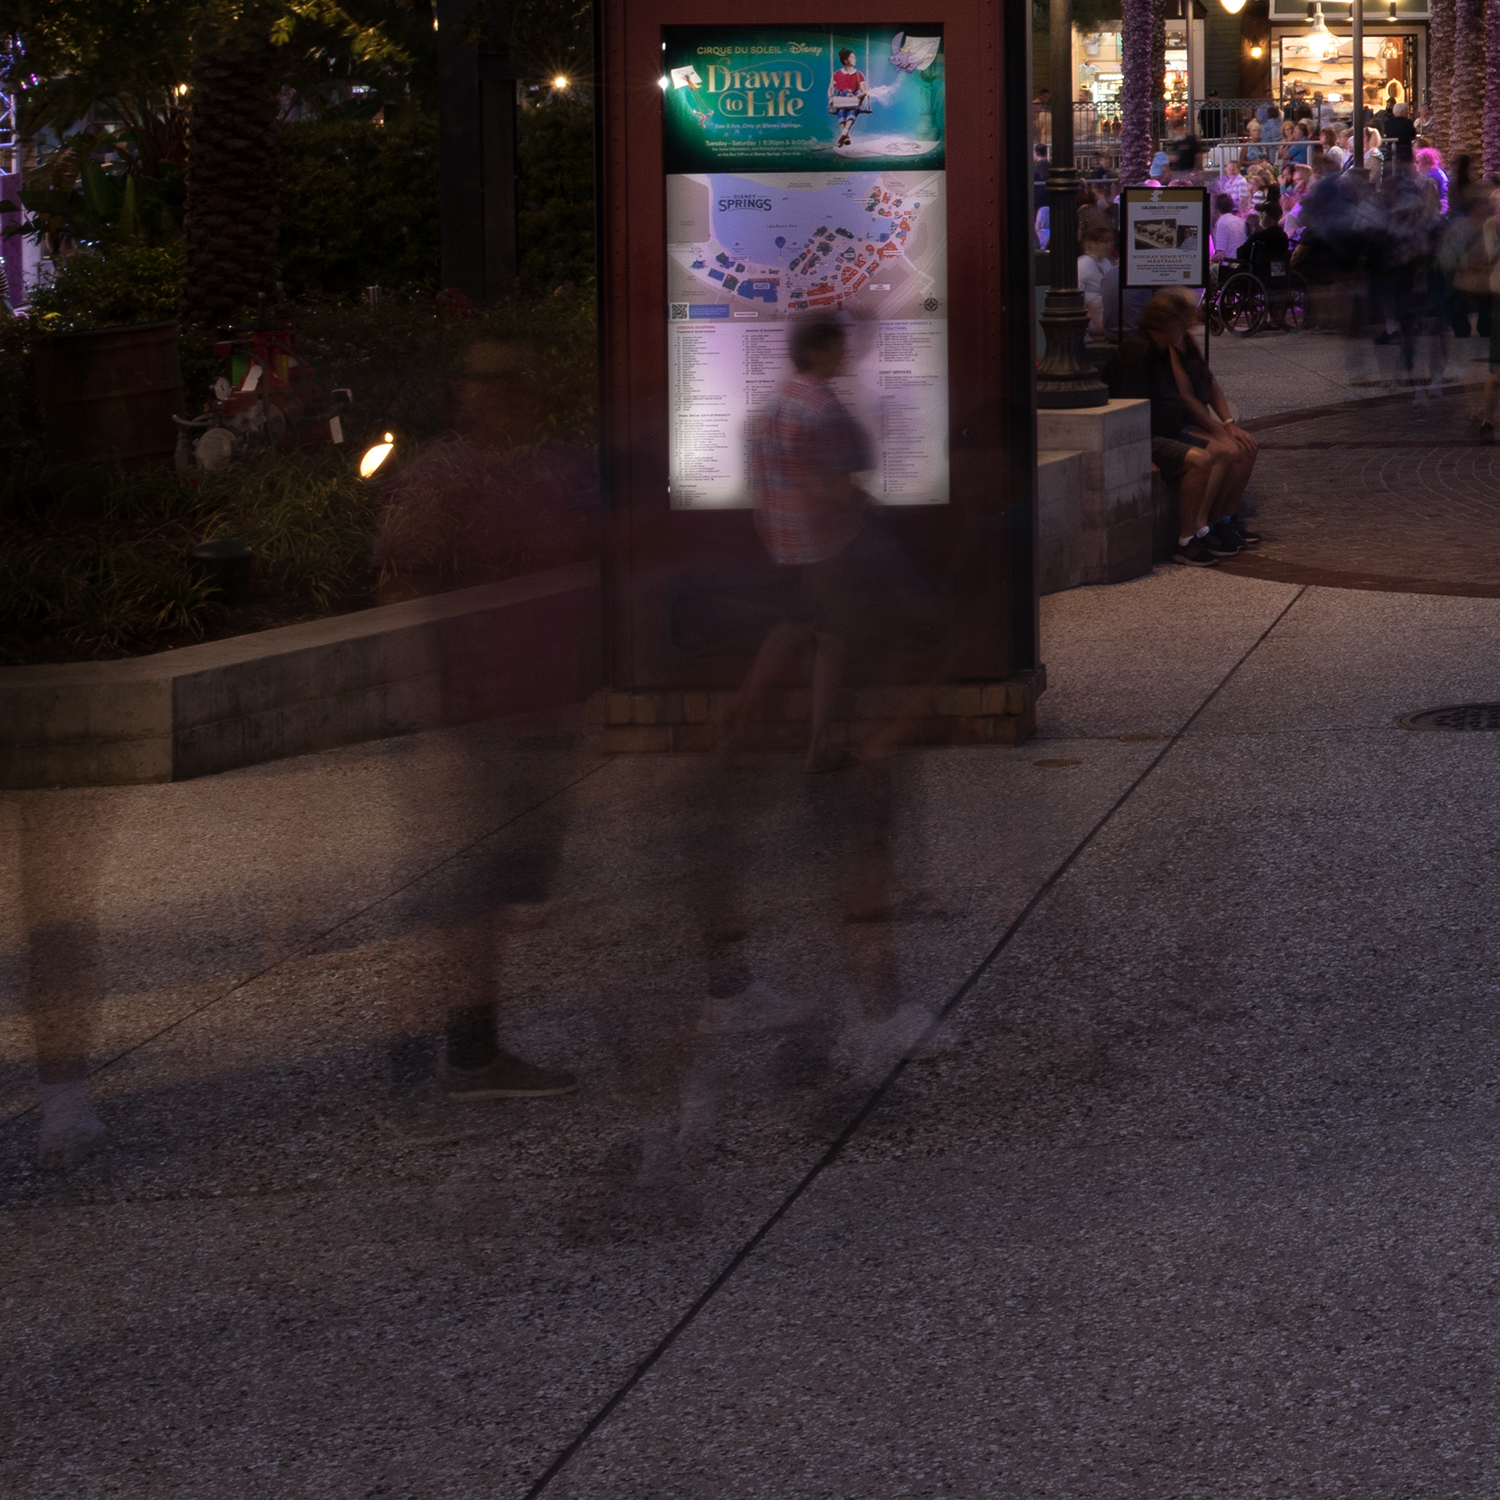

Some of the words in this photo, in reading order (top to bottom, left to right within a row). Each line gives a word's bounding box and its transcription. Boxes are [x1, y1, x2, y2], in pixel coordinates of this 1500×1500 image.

[696, 46, 733, 57] CIRQUE
[734, 46, 749, 55] DU
[750, 46, 782, 54] SOLEIL
[787, 41, 823, 57] Disney
[706, 57, 815, 93] Drawn
[724, 96, 744, 111] to
[743, 89, 806, 117] Life
[718, 198, 773, 212] SPRINGS
